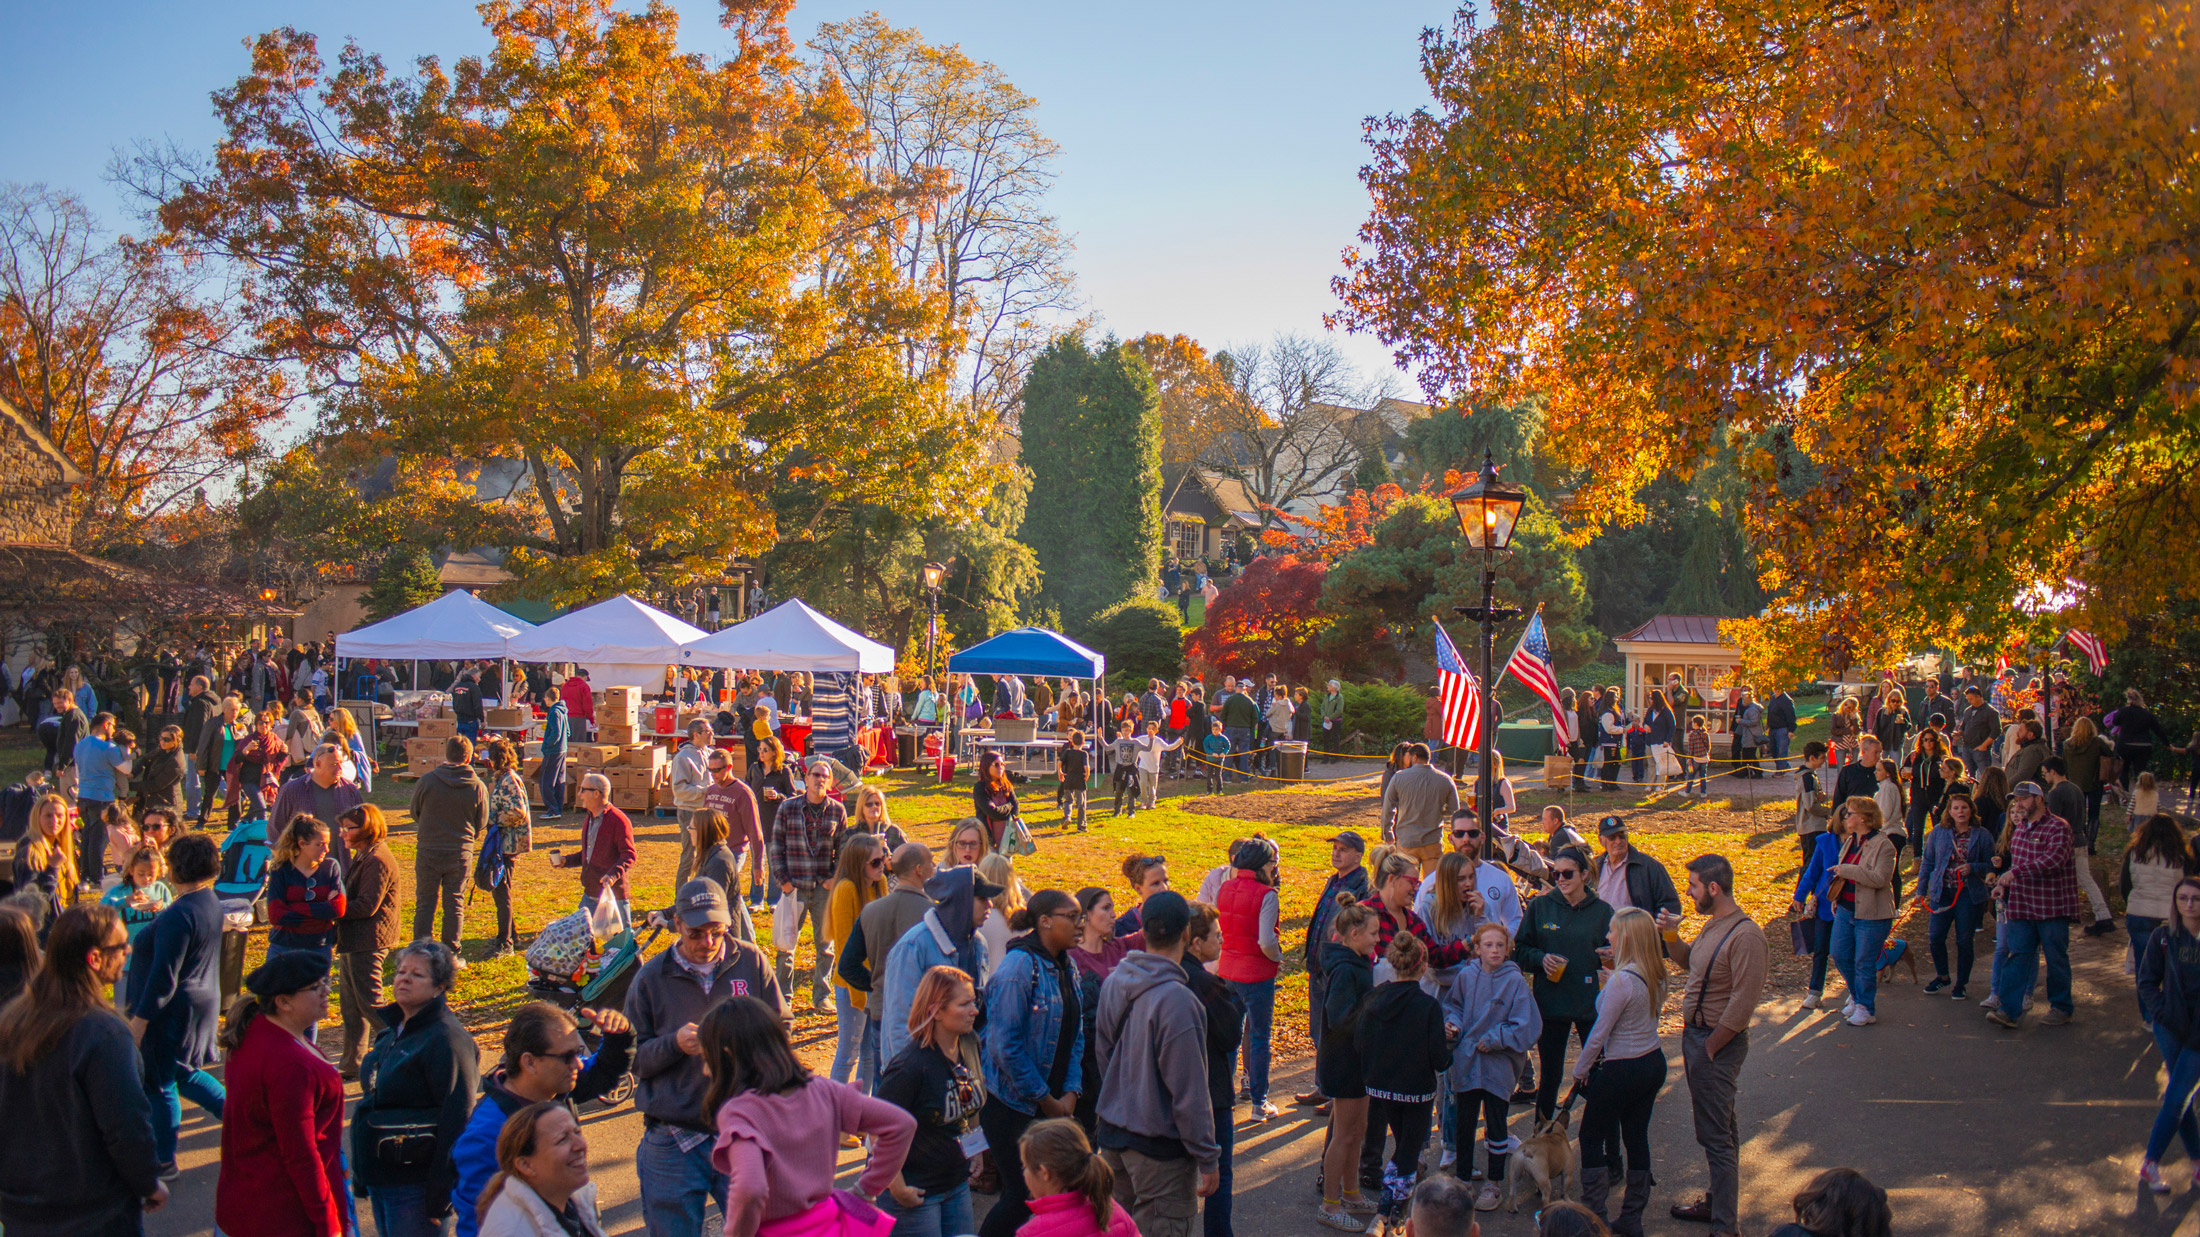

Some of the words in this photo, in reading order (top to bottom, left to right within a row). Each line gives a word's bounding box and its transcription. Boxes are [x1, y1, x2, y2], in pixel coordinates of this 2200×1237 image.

[730, 979, 749, 997] R
[1368, 1087, 1392, 1100] BELIEVE
[1393, 1091, 1420, 1103] BELIEVE
